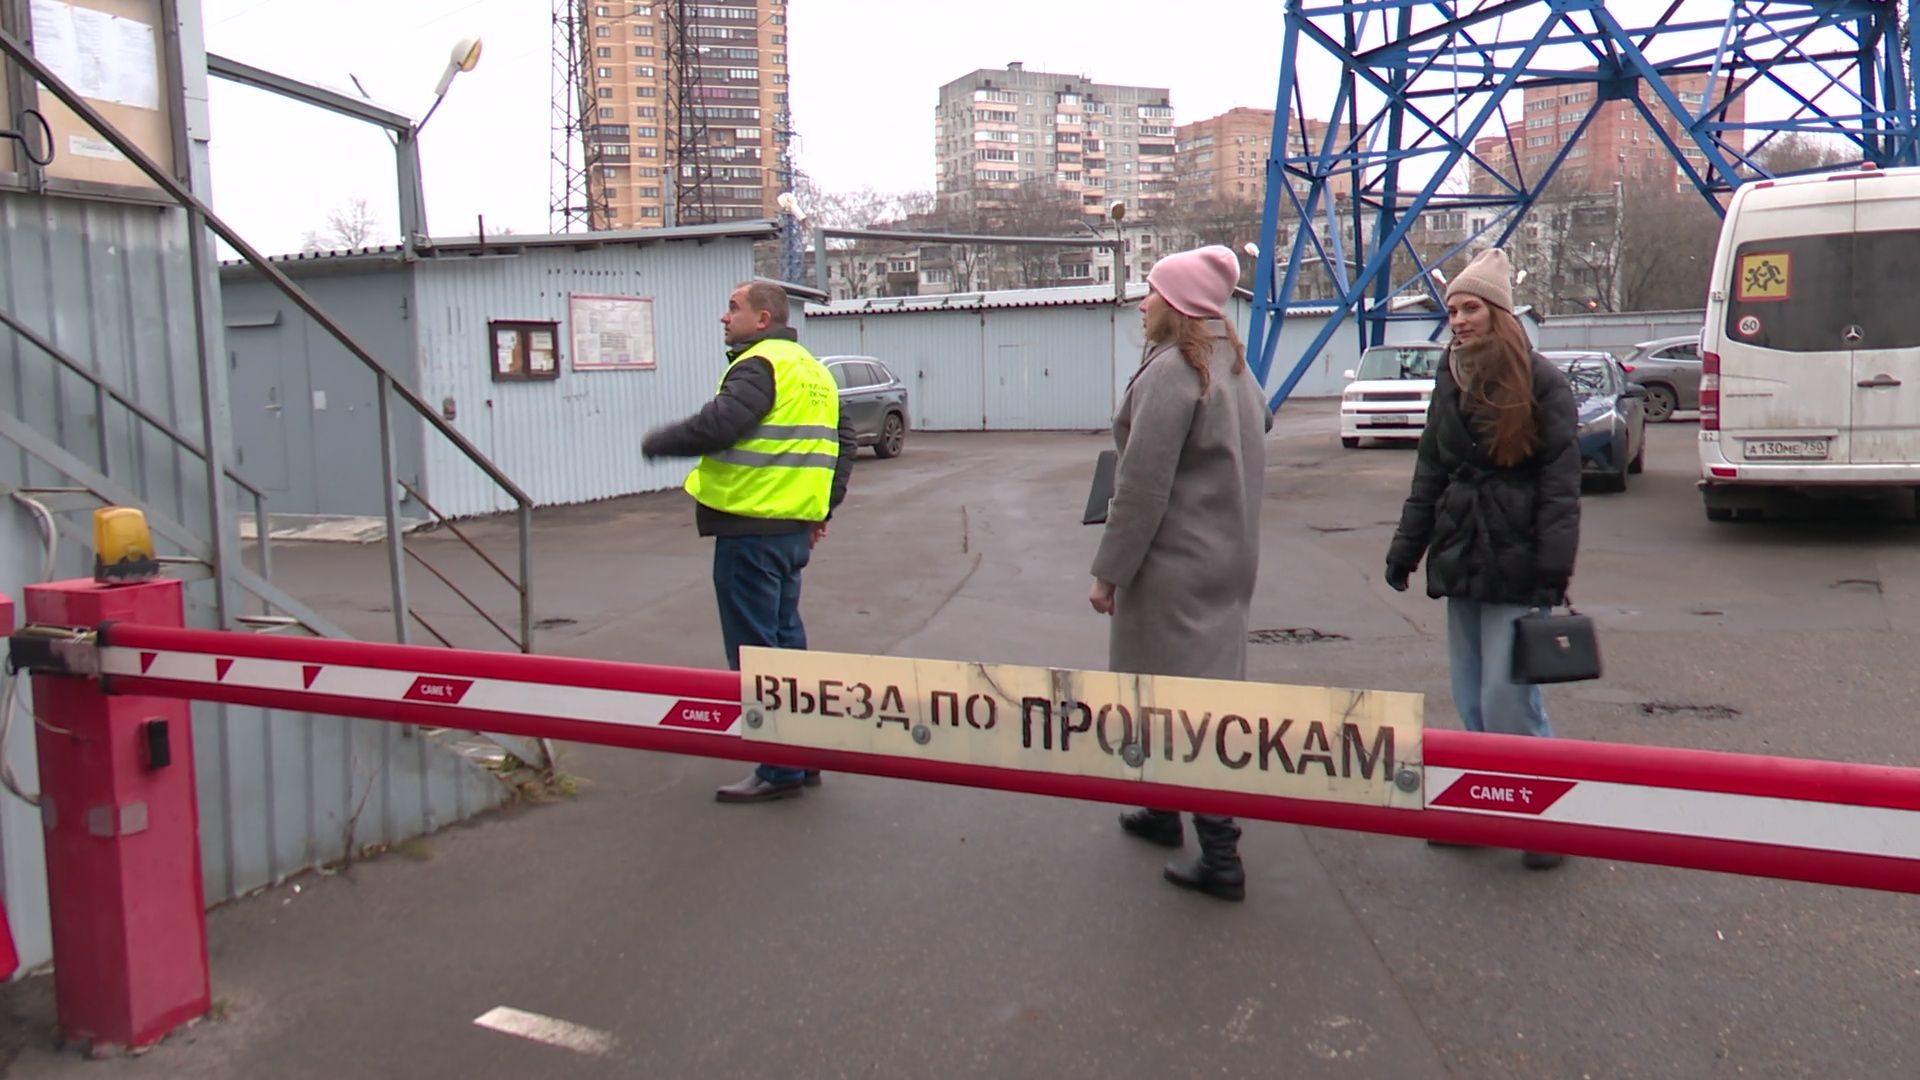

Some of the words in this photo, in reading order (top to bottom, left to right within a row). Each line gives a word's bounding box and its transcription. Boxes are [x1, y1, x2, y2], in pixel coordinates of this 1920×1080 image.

[1742, 320, 1757, 331] 60
[682, 708, 711, 722] CAME
[755, 674, 911, 730] ВЪЕЗД
[930, 690, 997, 730] ПО
[1021, 696, 1395, 782] ПРОПУСКАМ
[1470, 785, 1515, 802] CAME
